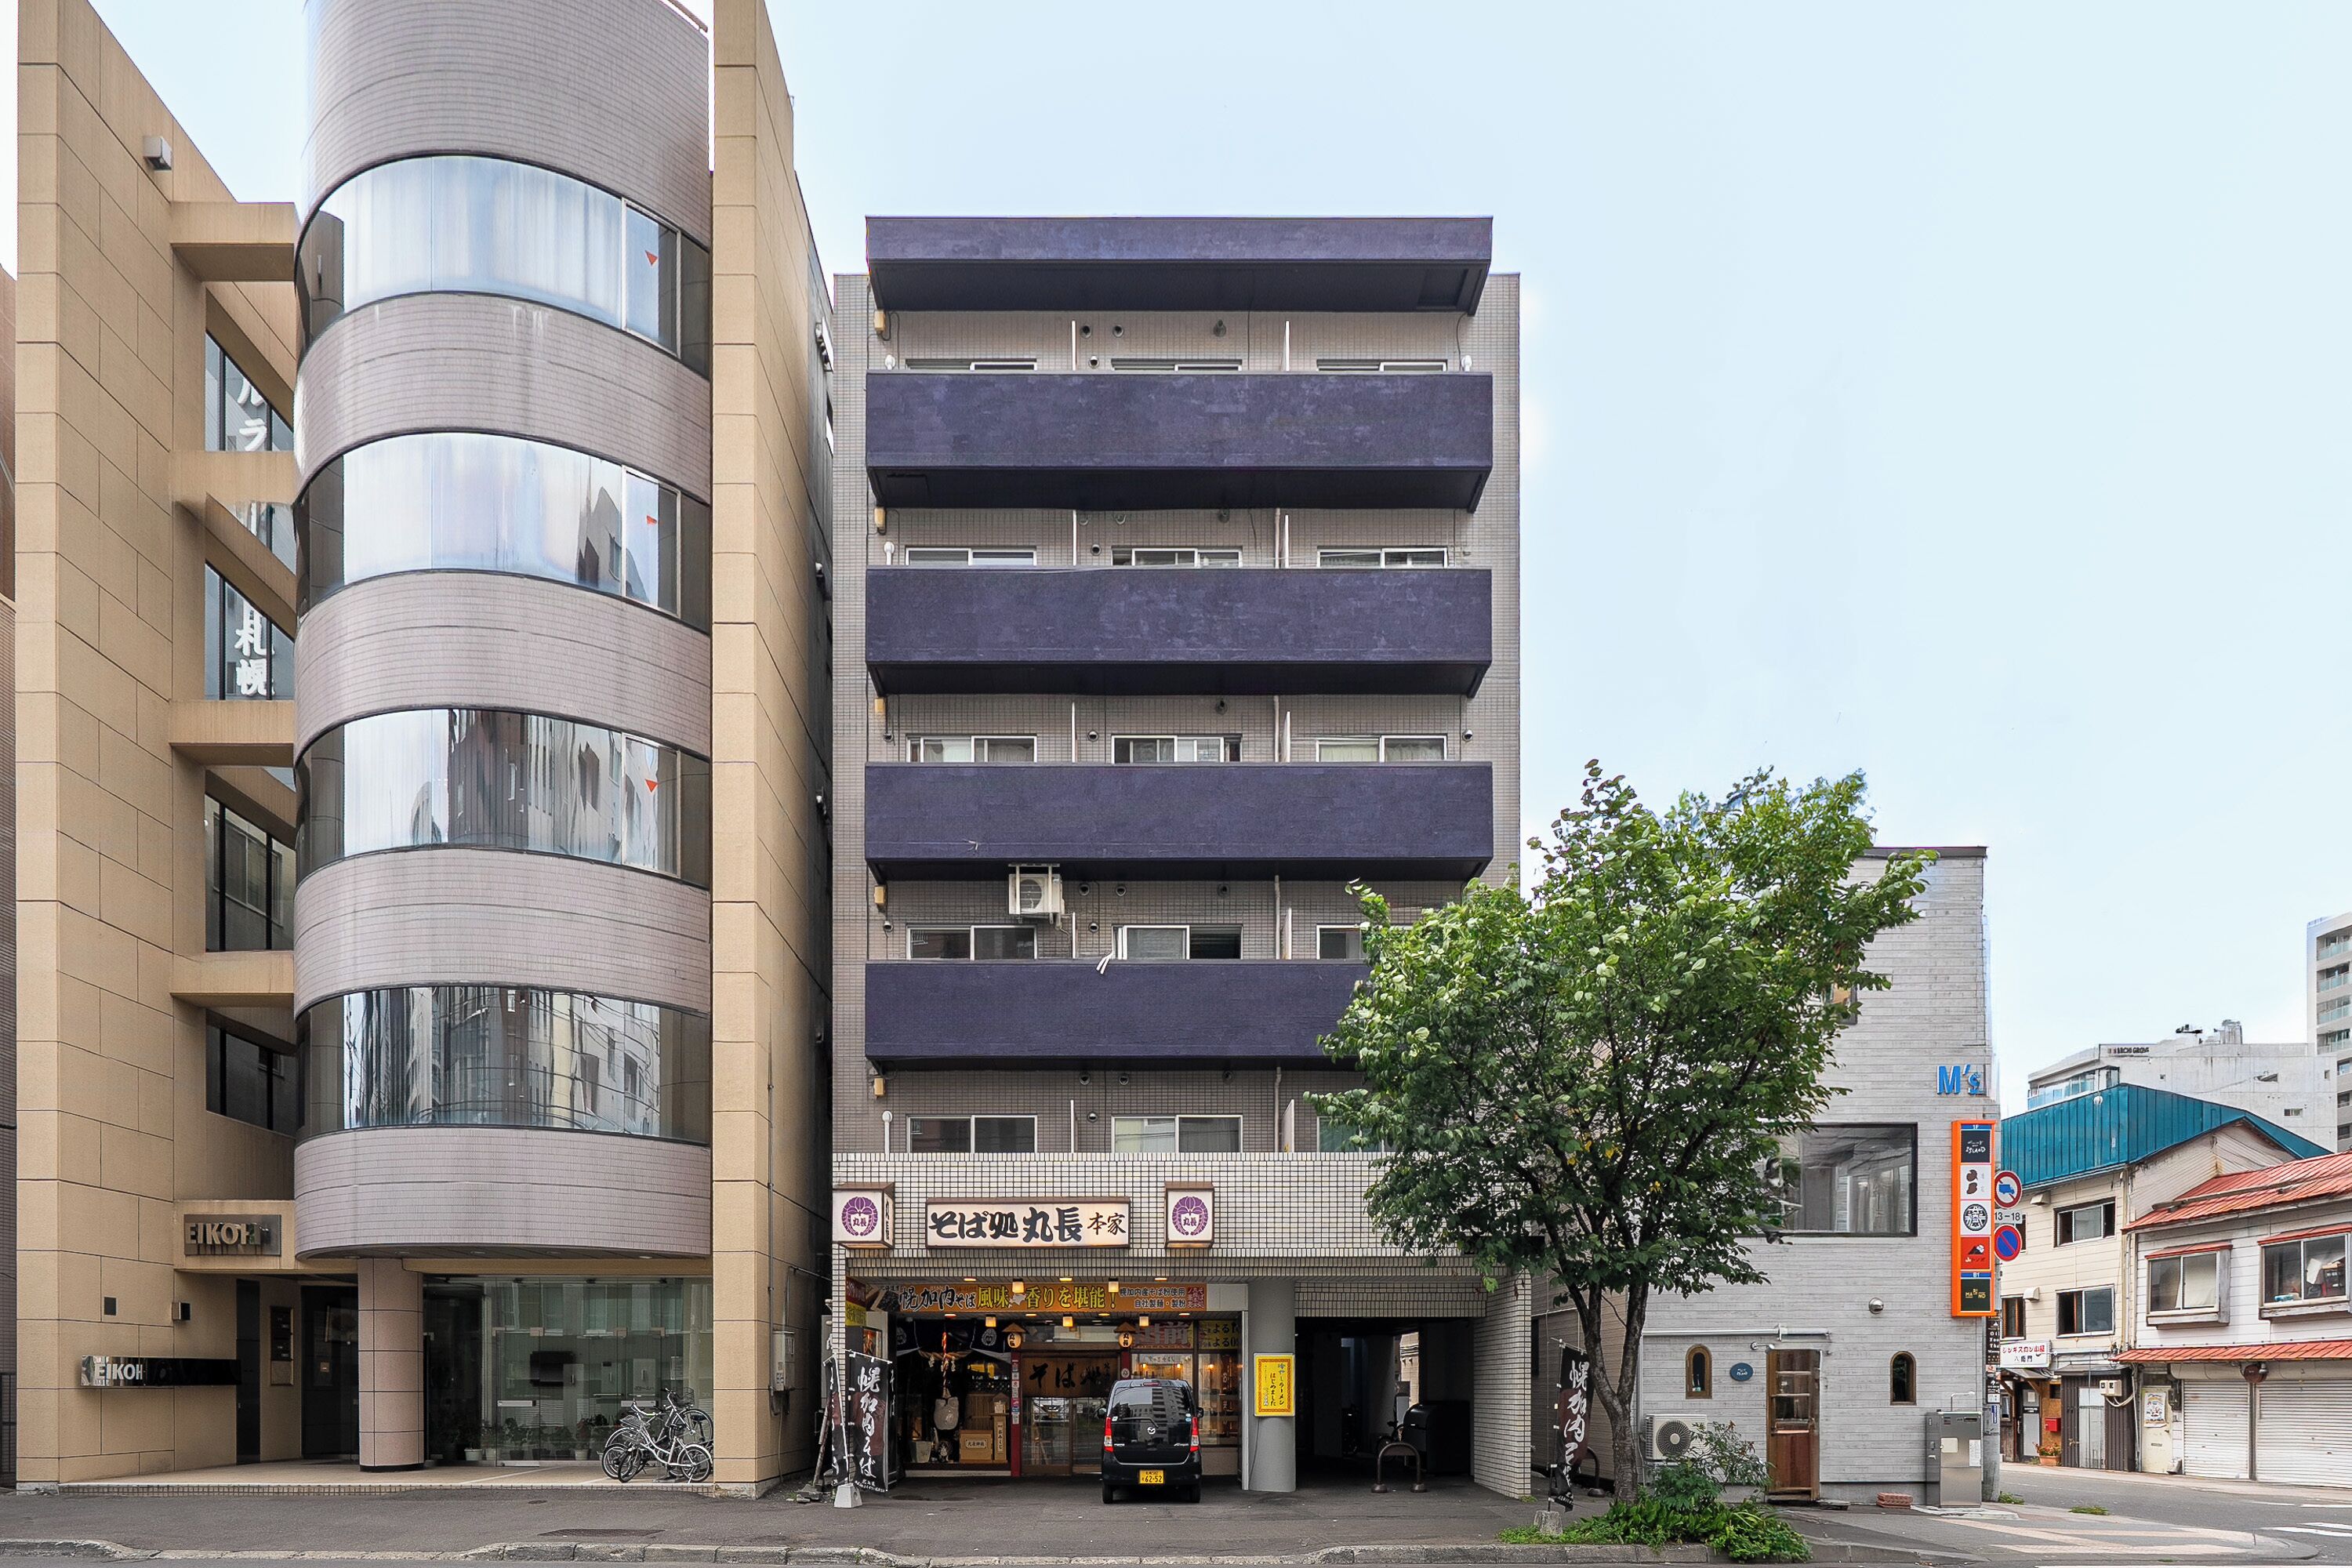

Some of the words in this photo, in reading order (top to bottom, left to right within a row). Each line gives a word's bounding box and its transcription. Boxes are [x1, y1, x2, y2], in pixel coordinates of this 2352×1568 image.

[978, 1287, 1010, 1308] 風味
[94, 1363, 143, 1381] EIKOH
[1145, 1475, 1163, 1483] 62-52
